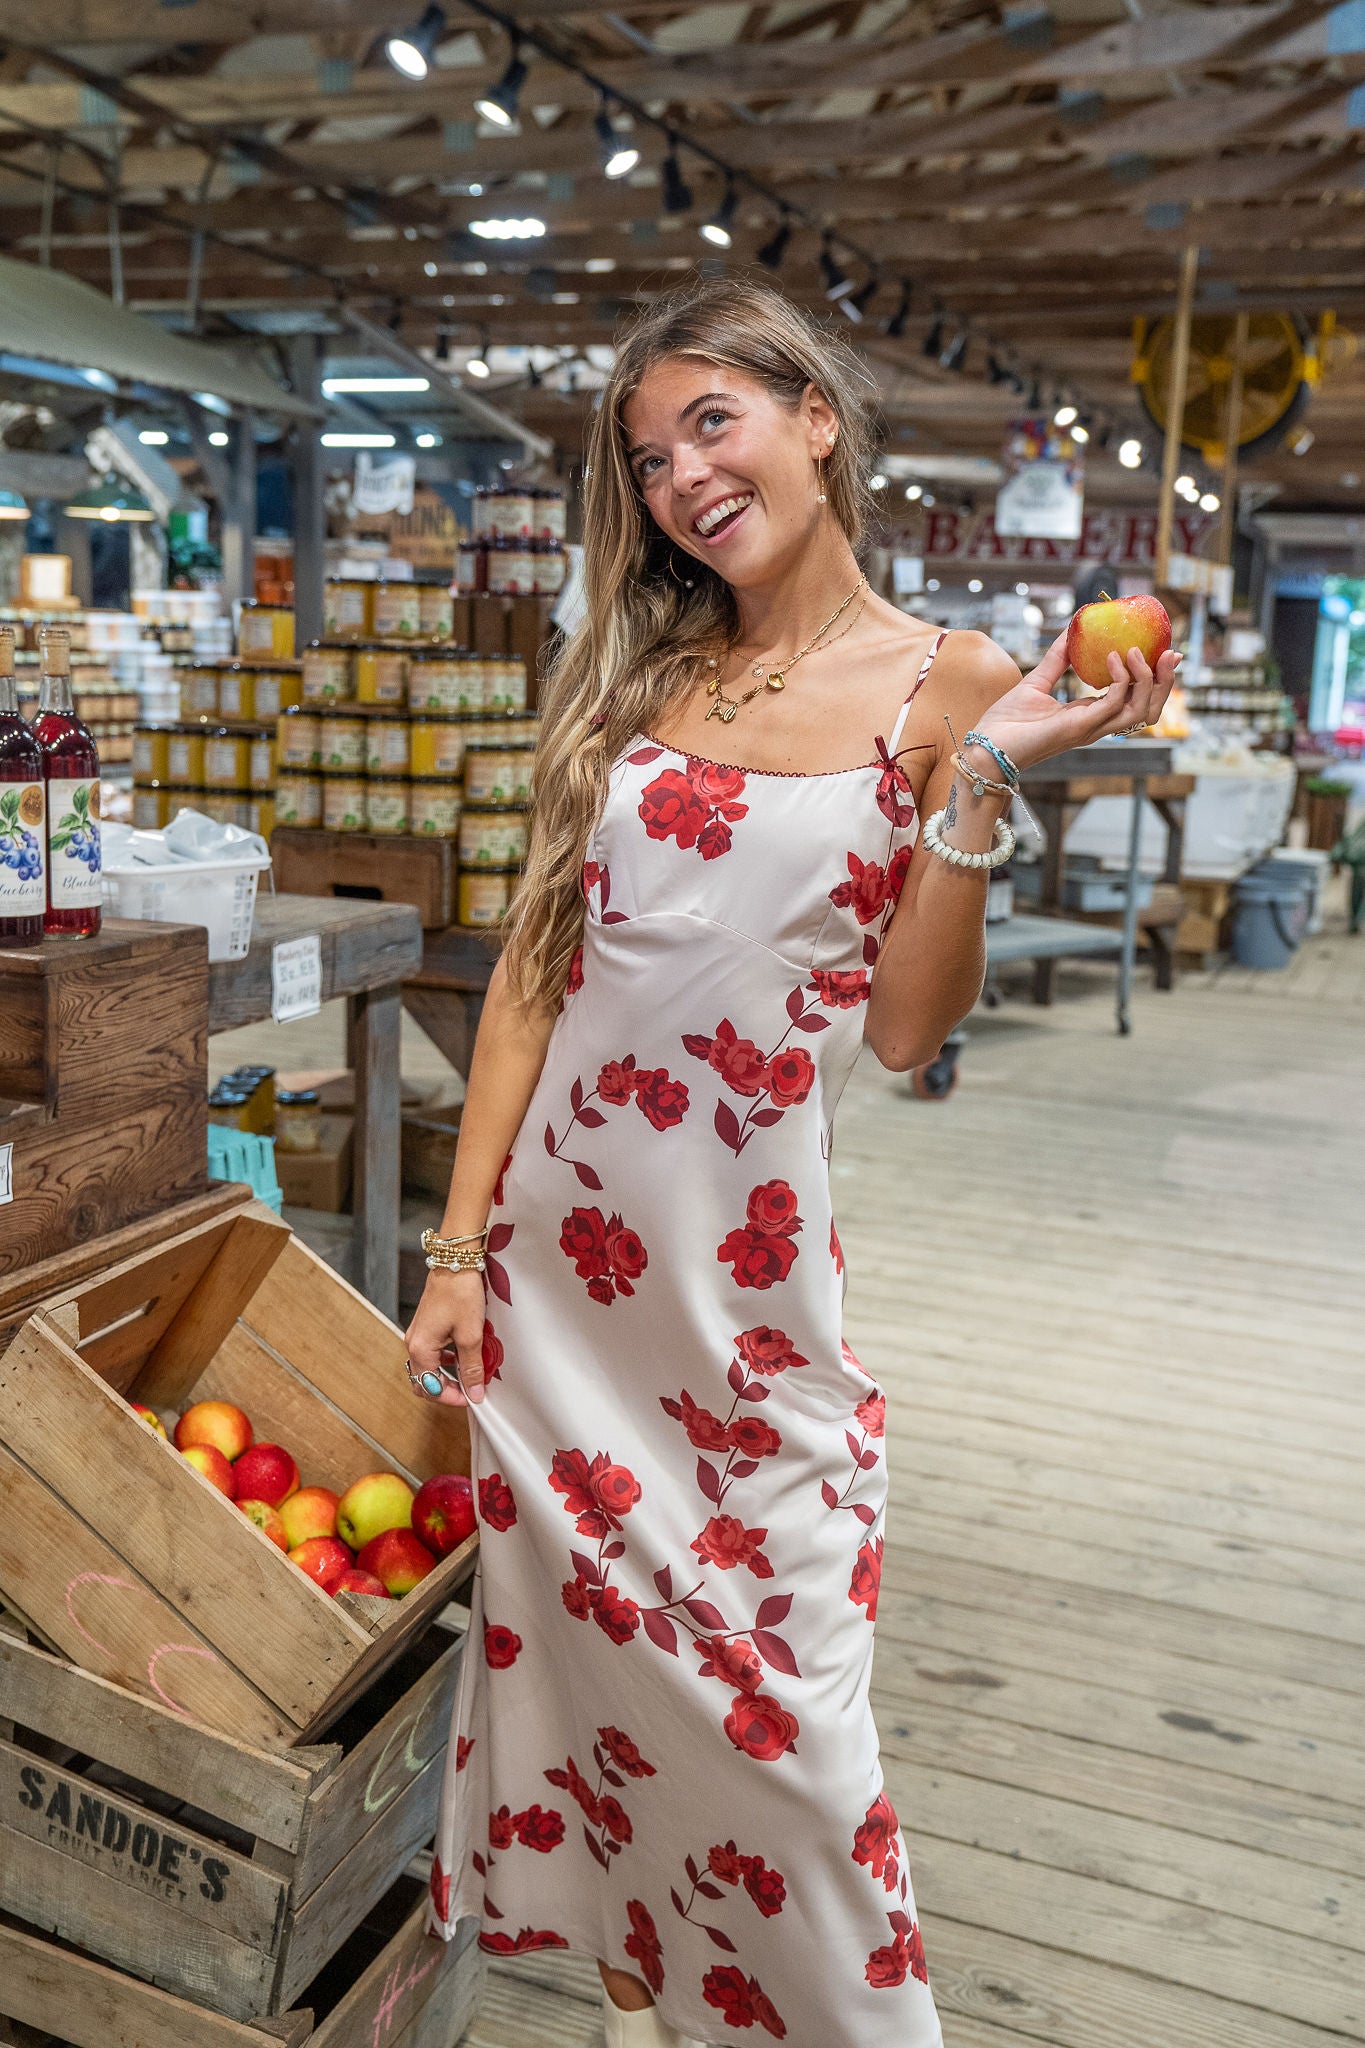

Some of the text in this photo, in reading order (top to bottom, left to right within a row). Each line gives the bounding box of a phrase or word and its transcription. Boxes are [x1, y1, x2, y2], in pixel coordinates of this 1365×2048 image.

[0, 883, 43, 899] lueberry
[18, 1766, 231, 1903] SANDOE'S
[47, 1823, 105, 1861] FRUIT
